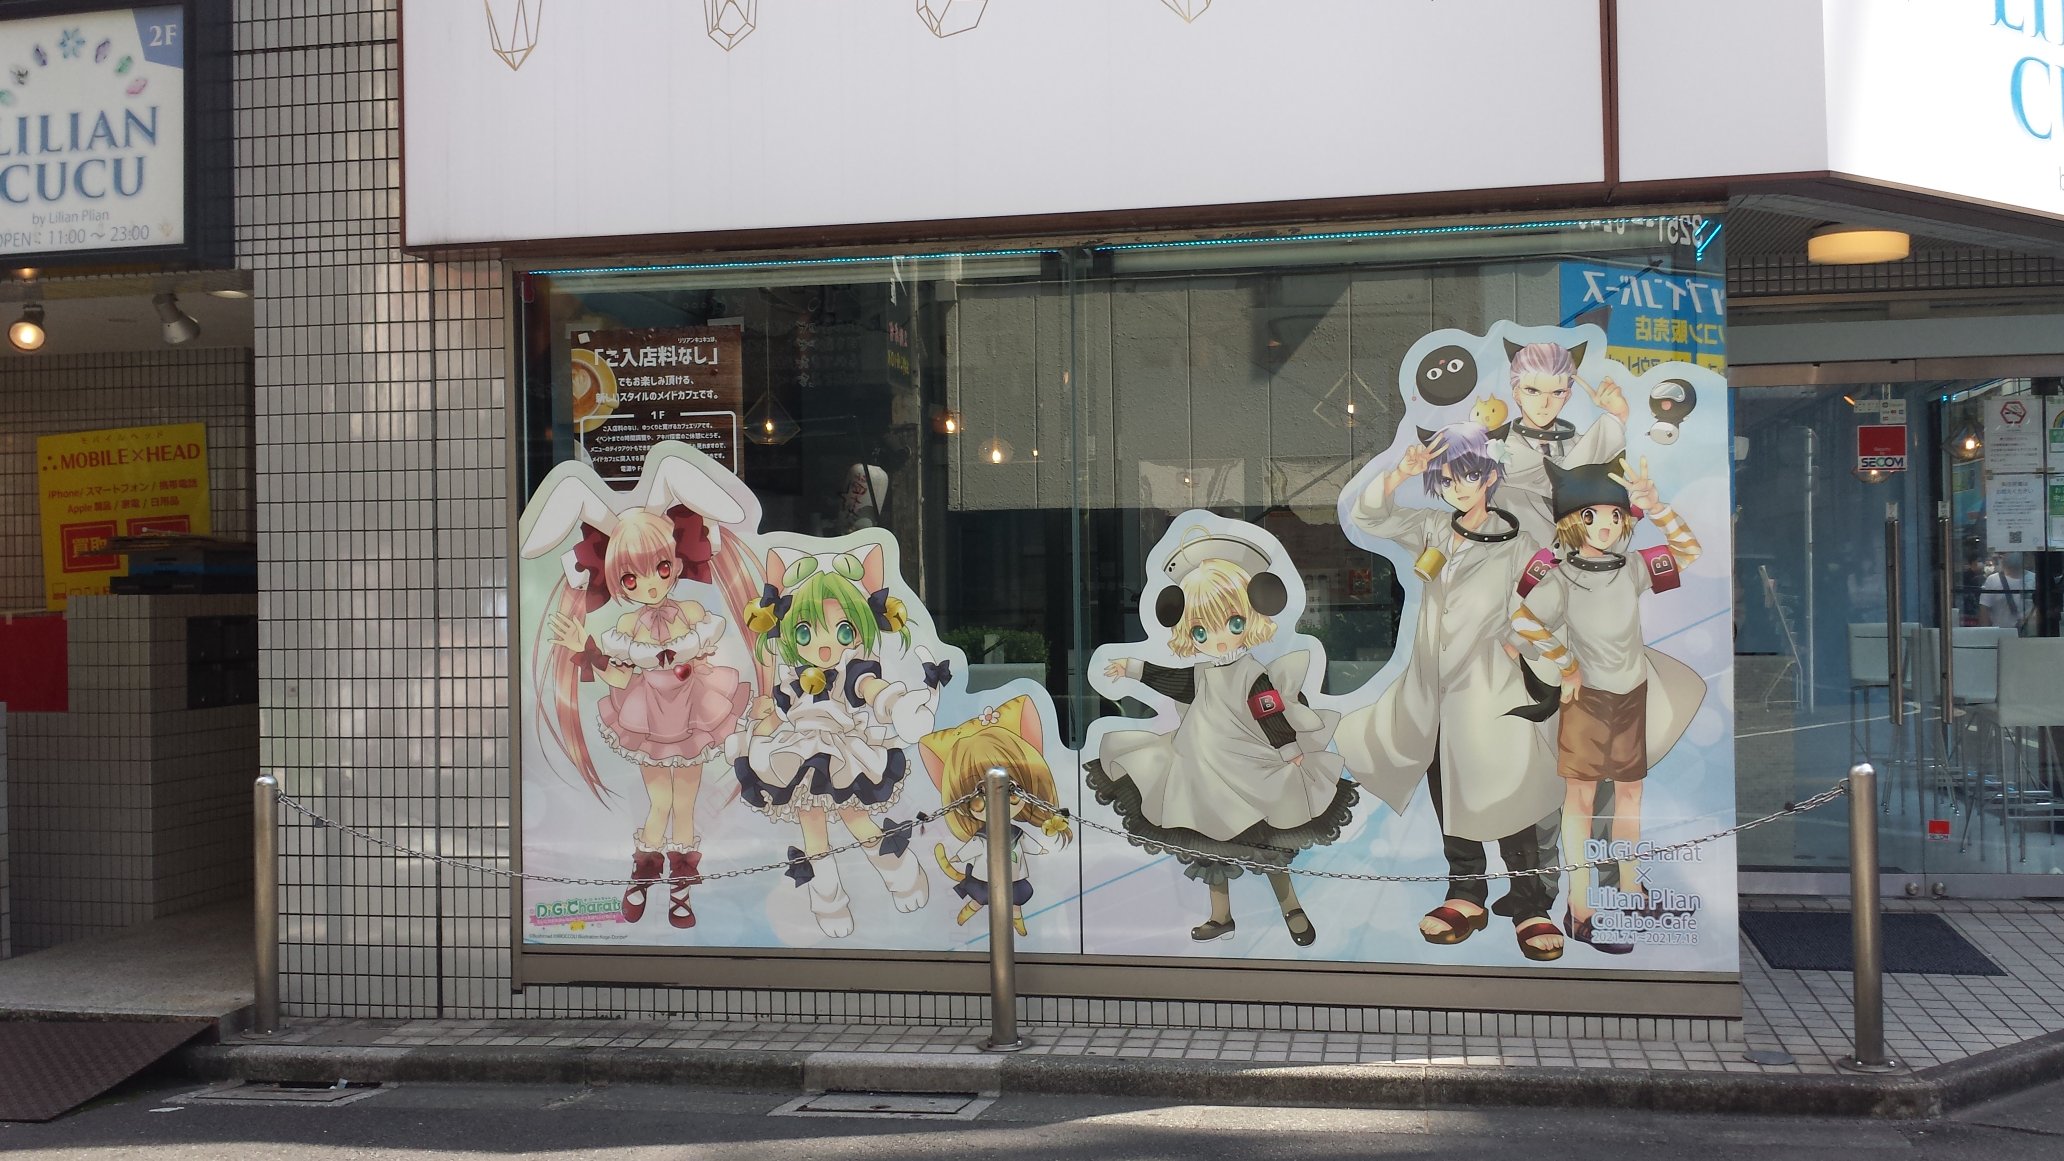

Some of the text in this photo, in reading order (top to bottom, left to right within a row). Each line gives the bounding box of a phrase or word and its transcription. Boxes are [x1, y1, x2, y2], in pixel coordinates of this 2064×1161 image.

[150, 24, 177, 47] 2F
[2010, 56, 2064, 141] C
[0, 106, 158, 156] ILIAN
[0, 156, 147, 203] CUCU
[32, 209, 110, 226] by Lilian Plian
[49, 229, 86, 244] 11:00
[110, 225, 150, 242] 23:00
[594, 345, 719, 368] 「ご入店料なし」
[618, 375, 695, 387] でもお楽しみ頂ける、
[596, 389, 719, 404] 新しいスタイルのメイドカフェです。
[650, 410, 666, 420] 1F
[1861, 457, 1904, 468] SECOM
[86, 482, 149, 497] スマートフォン
[67, 503, 92, 514] Apple
[151, 496, 180, 507] 日用品
[1258, 694, 1276, 712] B
[1588, 887, 1701, 910] Lilian Plian
